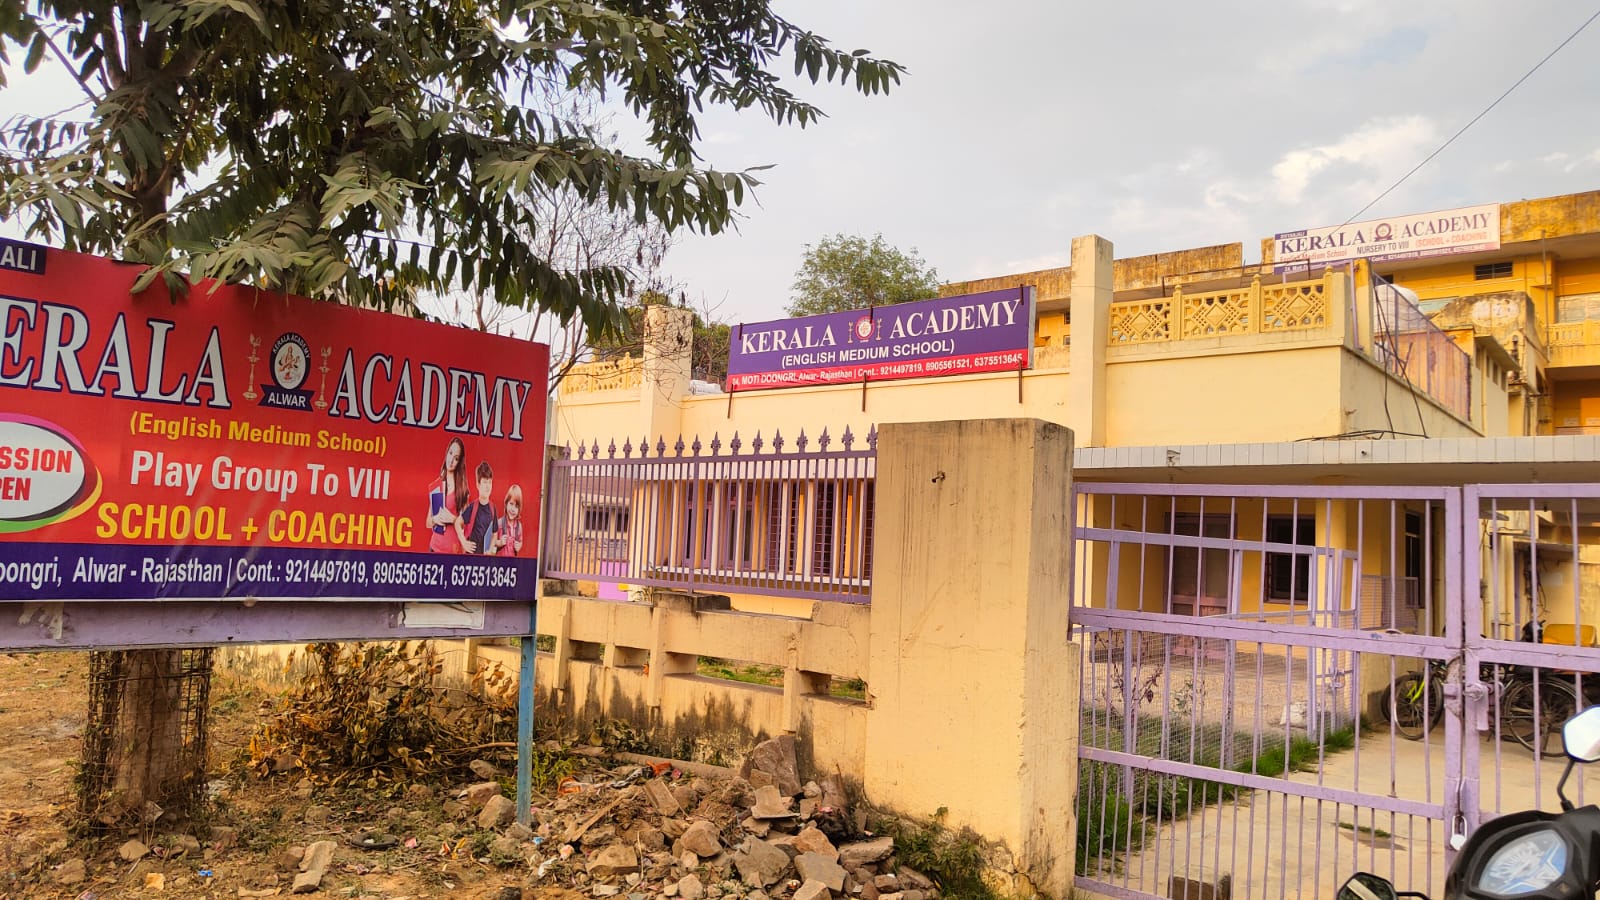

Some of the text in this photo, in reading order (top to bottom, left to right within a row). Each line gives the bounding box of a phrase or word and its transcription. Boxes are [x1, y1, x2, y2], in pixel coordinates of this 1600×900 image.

[1280, 213, 1492, 254] KERALA ACADEMY
[1357, 243, 1386, 255] NURSERY
[1388, 242, 1397, 251] TO
[0, 245, 37, 271] ALI
[740, 324, 837, 355] KERALA
[889, 299, 1020, 339] ACADEMY
[272, 333, 311, 359] KERALA ACADEMY
[781, 338, 955, 369] (ENGLISH MEDIUM SCHOOL)
[0, 297, 532, 441] ERALA ACADEMY
[741, 374, 760, 385] MOTI
[267, 392, 306, 408] ALWAR
[130, 411, 387, 457] (English Medium School)
[0, 446, 73, 473] SSION
[0, 477, 31, 501] EN
[130, 450, 390, 502] Play Group To VIII
[96, 502, 413, 548] SCHOOL + COACHING
[72, 556, 126, 583] Alwar
[141, 557, 223, 588] Rajasthan
[236, 558, 280, 583] Cont.:
[285, 559, 368, 588] 9214497819,
[372, 561, 448, 589] 8905561521,
[451, 565, 517, 588] 6375513645
